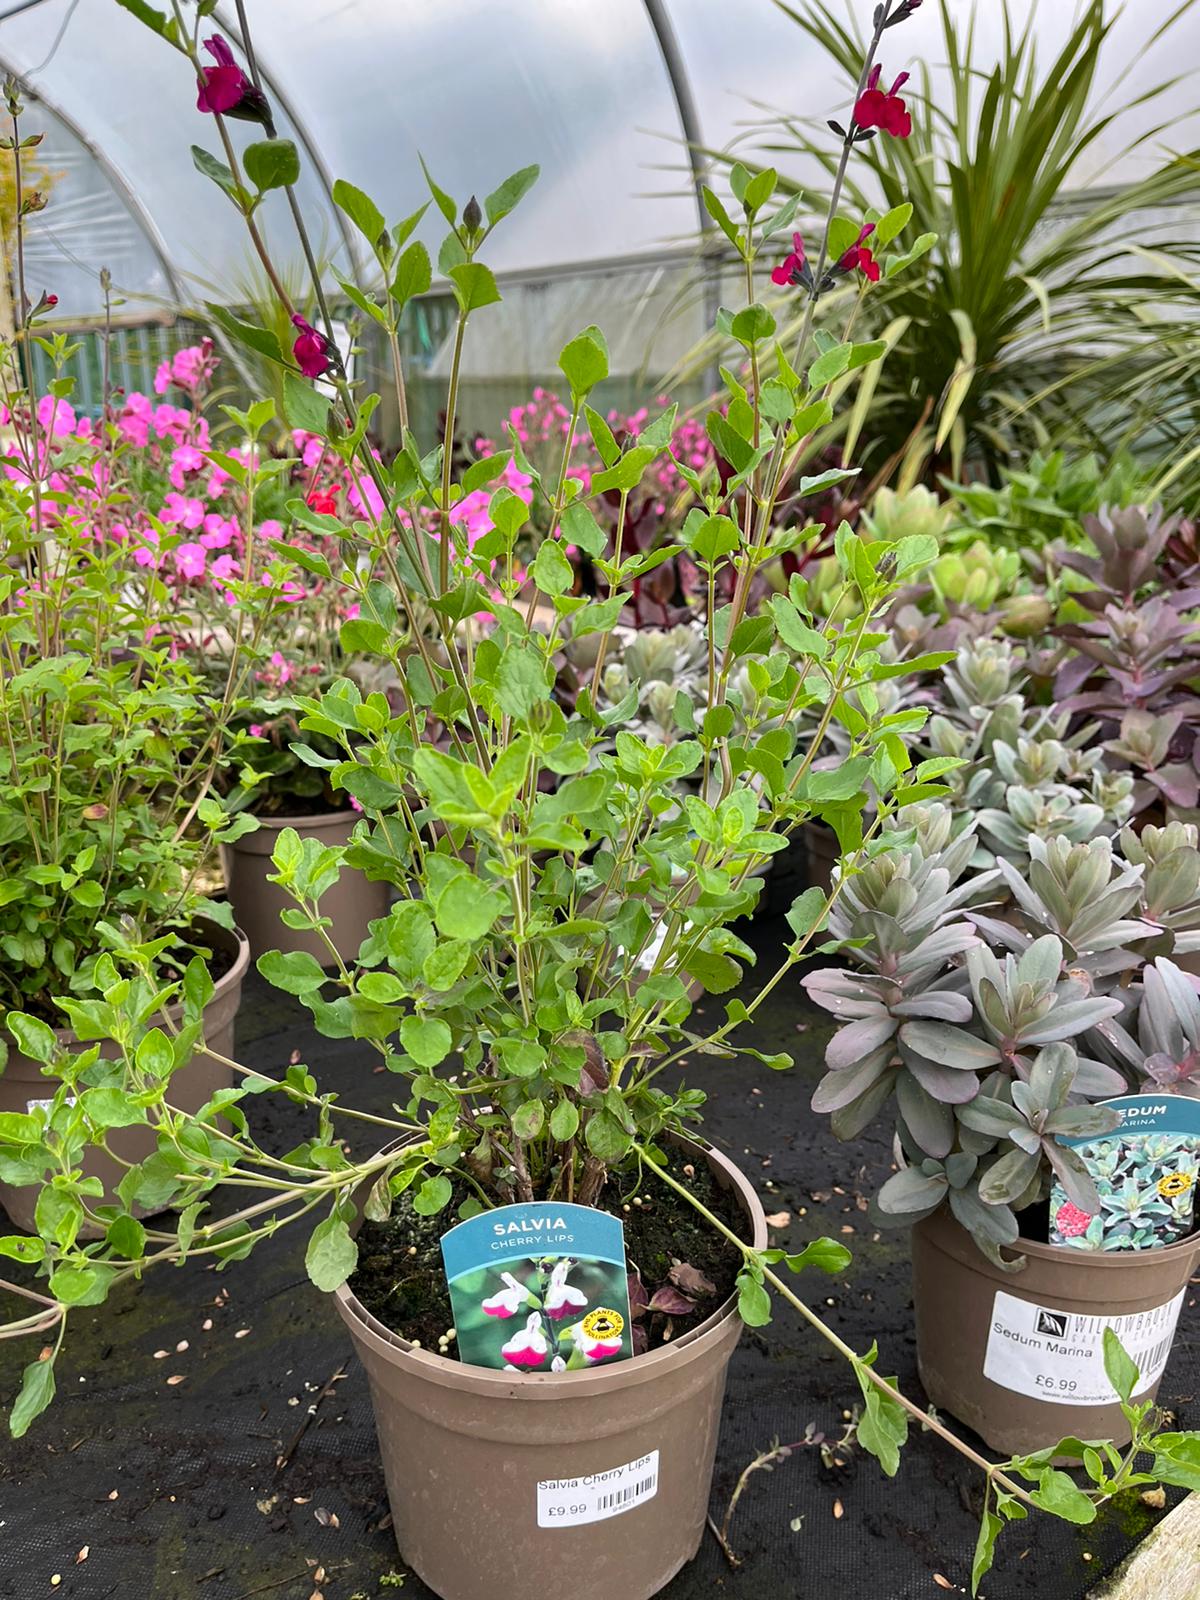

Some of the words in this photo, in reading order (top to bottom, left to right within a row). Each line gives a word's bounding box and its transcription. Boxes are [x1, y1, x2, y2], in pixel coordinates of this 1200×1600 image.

[1117, 1105, 1167, 1118] EDUM
[1117, 1118, 1156, 1127] ARINA
[493, 1217, 567, 1236] SALVIA
[490, 1235, 542, 1250] CHERRY
[547, 1234, 574, 1243] LIPS
[590, 1310, 614, 1319] PLANTS
[992, 1322, 1042, 1349] Sedum
[1046, 1341, 1093, 1358] Marina
[1034, 1374, 1078, 1392] £6.99
[539, 1480, 579, 1490] Salvia
[582, 1468, 624, 1486] Cherry
[628, 1456, 651, 1472] Lips
[548, 1503, 587, 1516] £9.99
